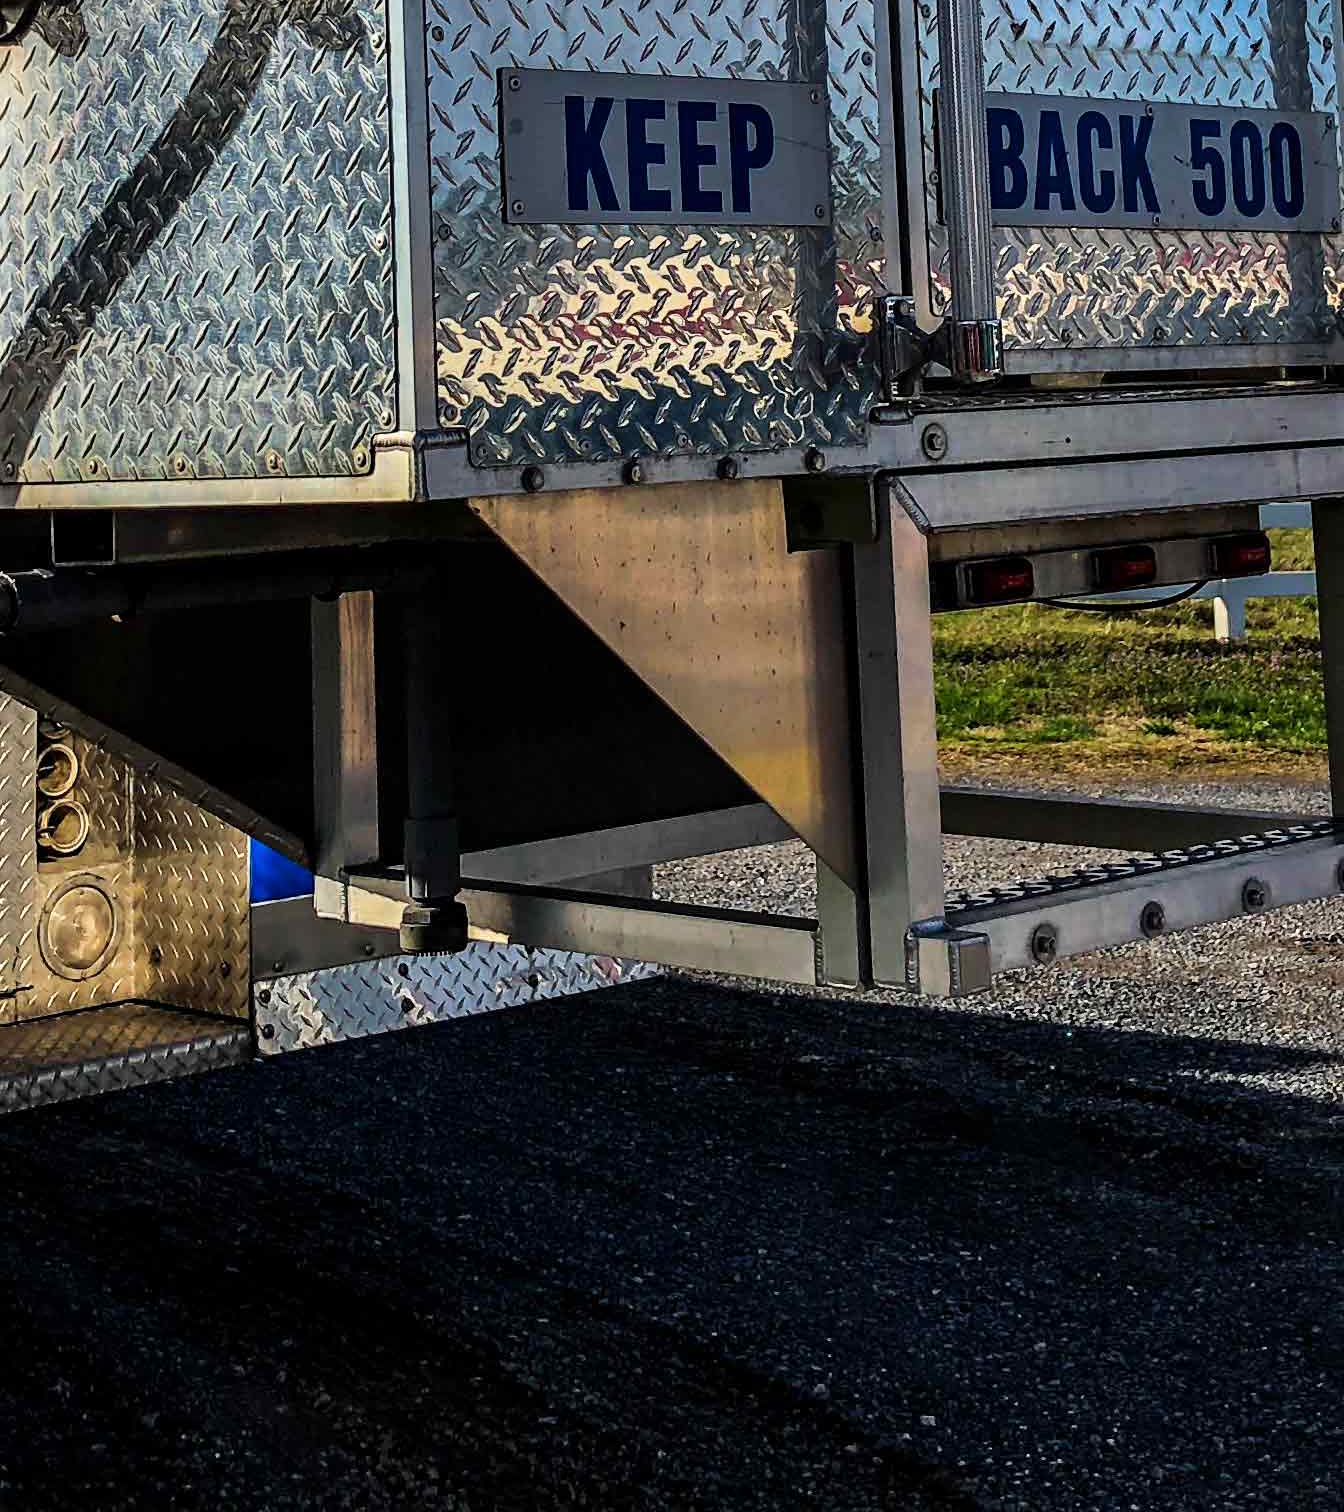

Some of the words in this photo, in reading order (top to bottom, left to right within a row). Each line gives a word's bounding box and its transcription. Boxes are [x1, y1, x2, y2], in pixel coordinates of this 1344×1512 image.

[564, 95, 775, 213] KEEP
[986, 107, 1162, 214] BACK
[1189, 118, 1306, 219] 500
